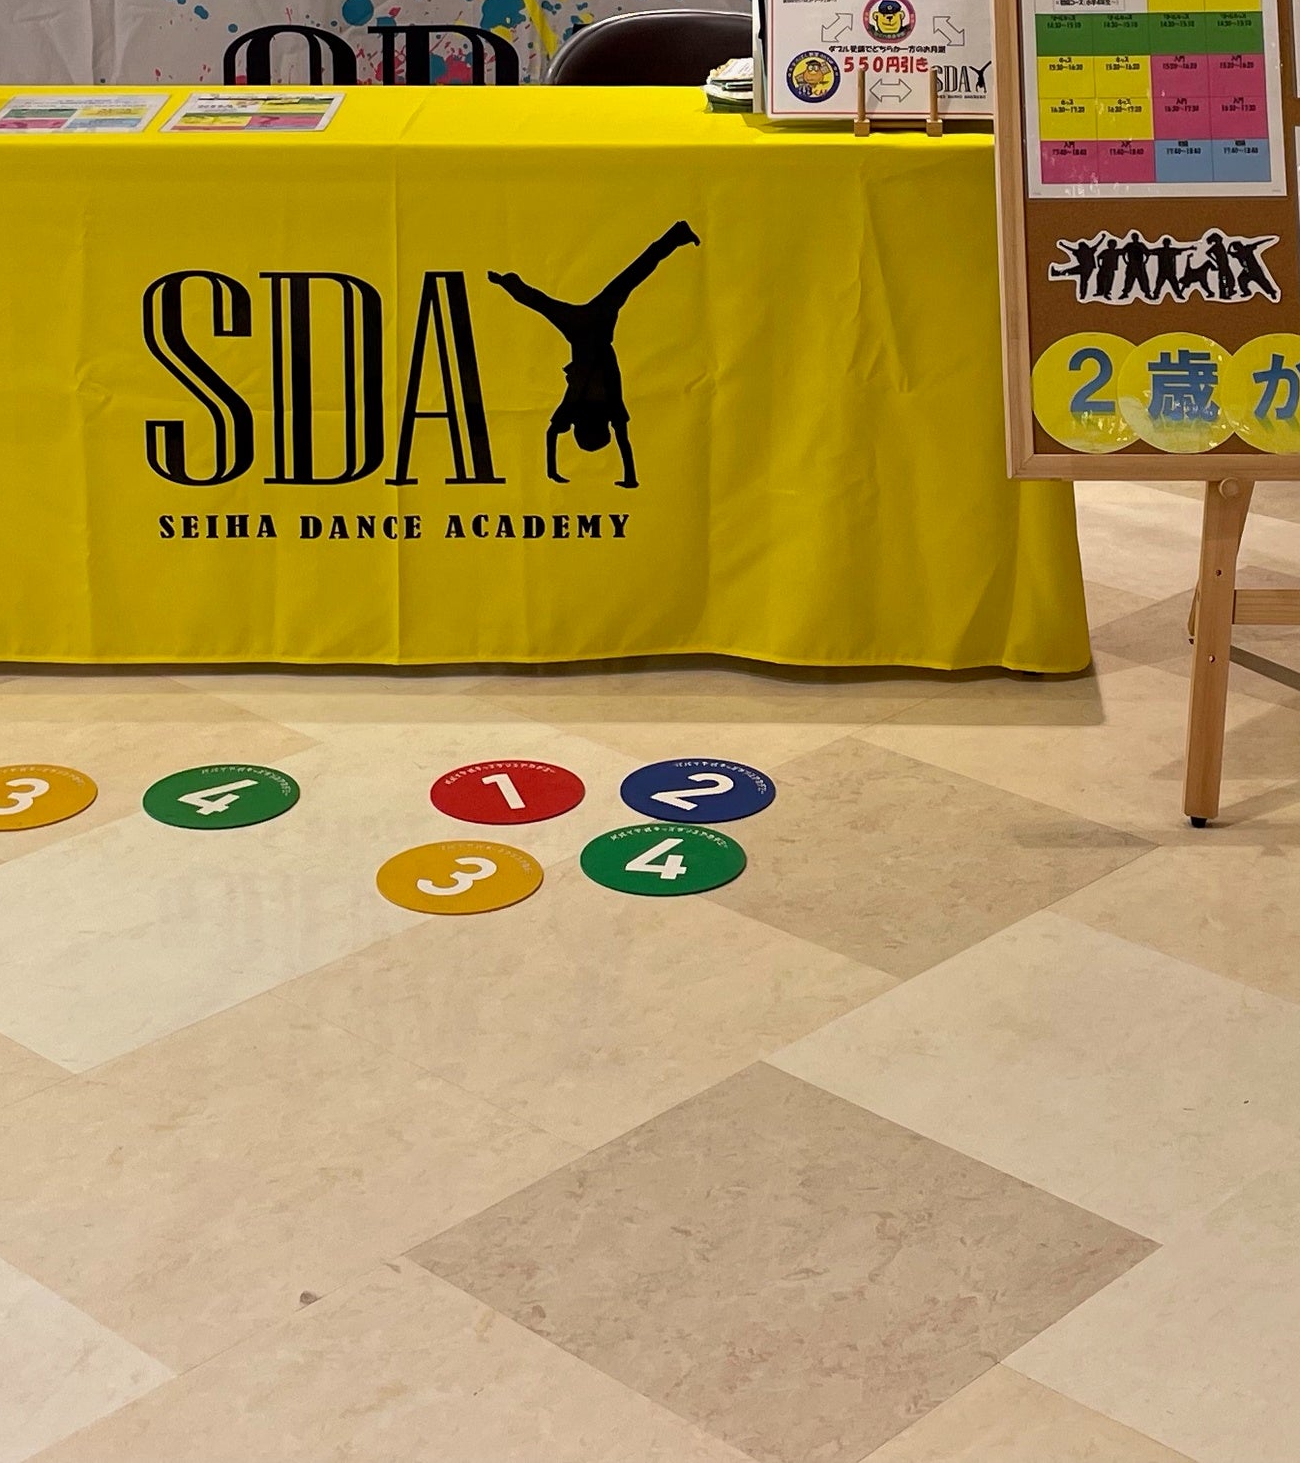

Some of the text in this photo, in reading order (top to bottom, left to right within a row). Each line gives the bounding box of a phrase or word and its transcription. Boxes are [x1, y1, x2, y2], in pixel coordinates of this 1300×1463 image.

[141, 269, 507, 487] SDA
[158, 513, 631, 540] SEIHA DANCE ACADEMY
[176, 778, 260, 816] 4
[481, 773, 526, 810] 1
[649, 772, 735, 811] 2
[415, 856, 498, 897] 3
[624, 838, 688, 880] 4
